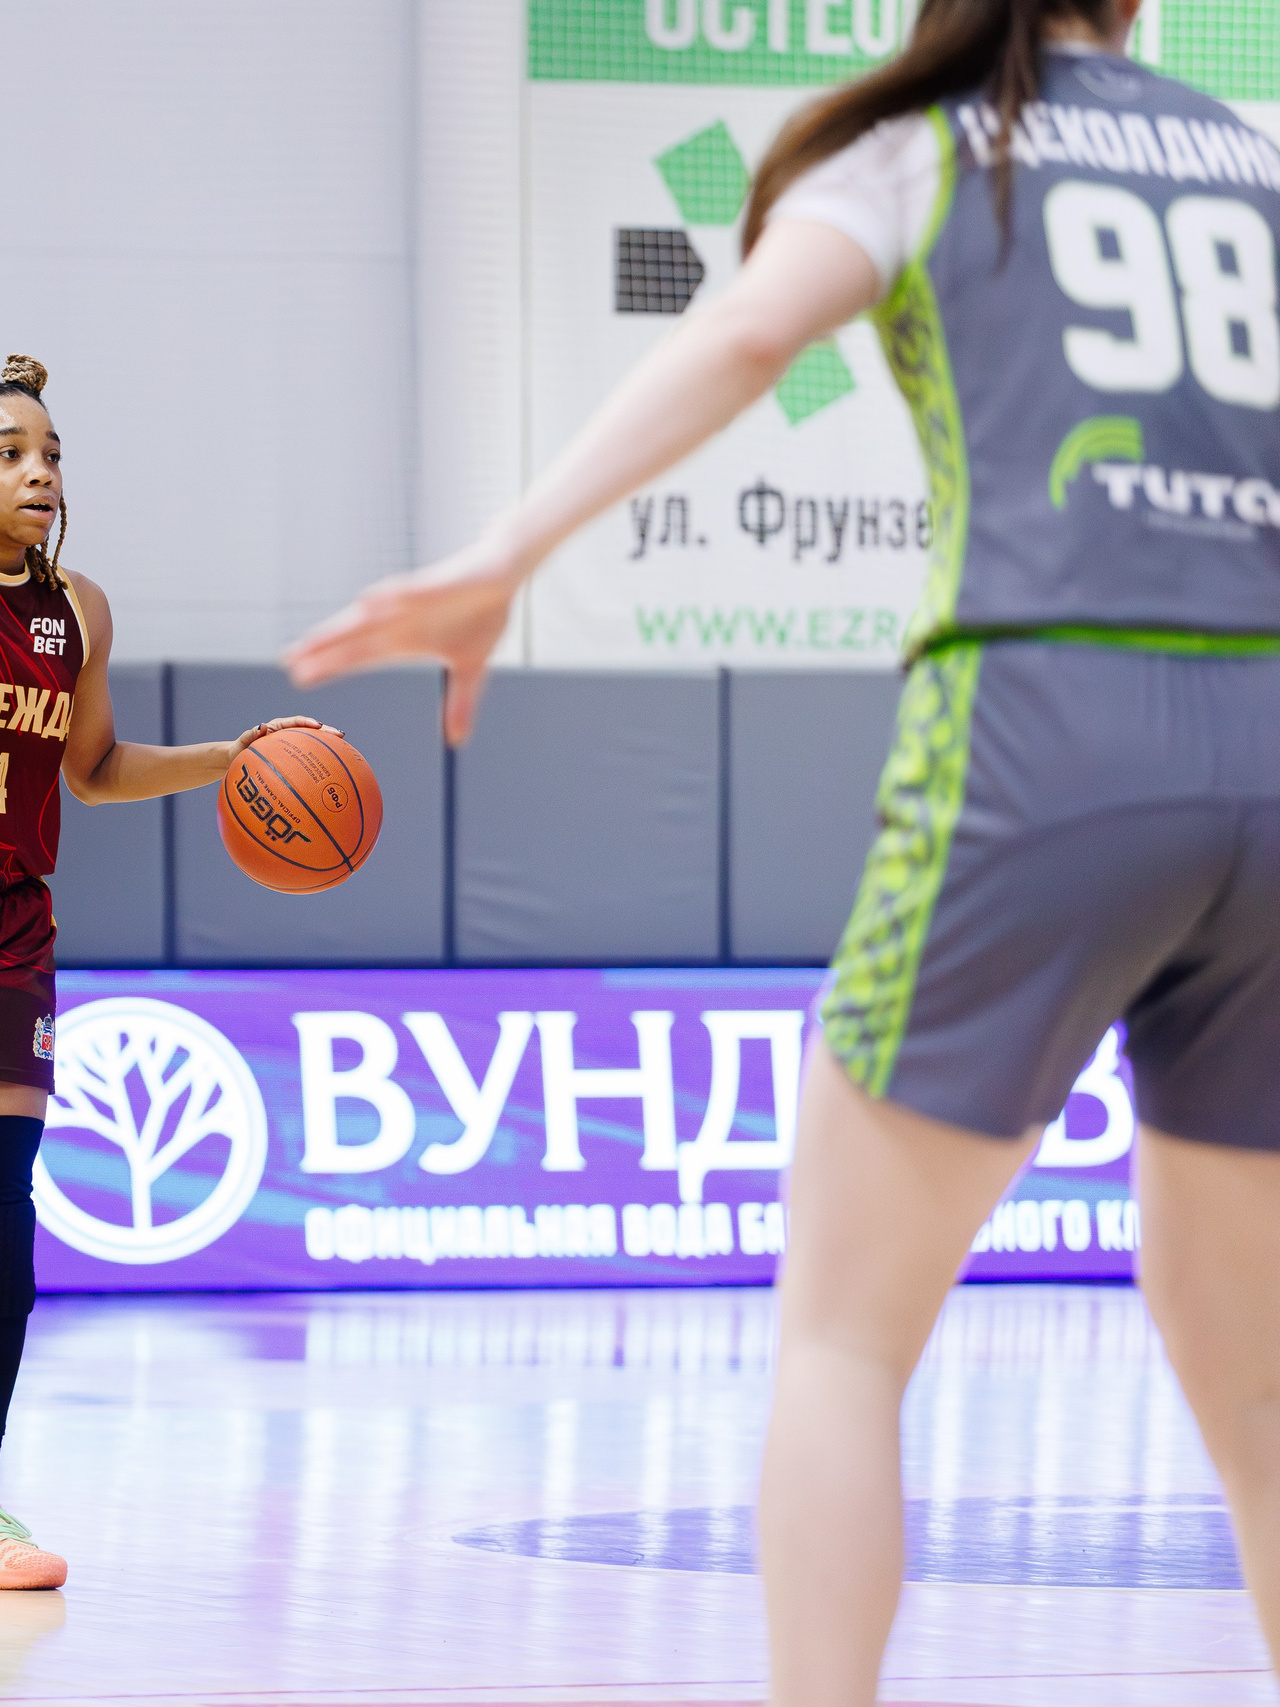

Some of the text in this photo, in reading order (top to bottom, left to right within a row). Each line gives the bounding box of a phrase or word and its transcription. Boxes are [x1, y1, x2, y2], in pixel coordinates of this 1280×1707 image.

[1042, 178, 1280, 412] 98
[629, 495, 707, 562] ул.
[29, 617, 66, 636] FON
[33, 635, 67, 656] BET
[236, 764, 312, 844] JÖGEL
[264, 784, 277, 801] GAME
[326, 786, 343, 809] РФБ
[277, 800, 301, 824] OFFICIAL
[305, 1203, 617, 1265] ОФИЦИАЛЬНАЯ
[622, 1202, 734, 1259] ВОДА
